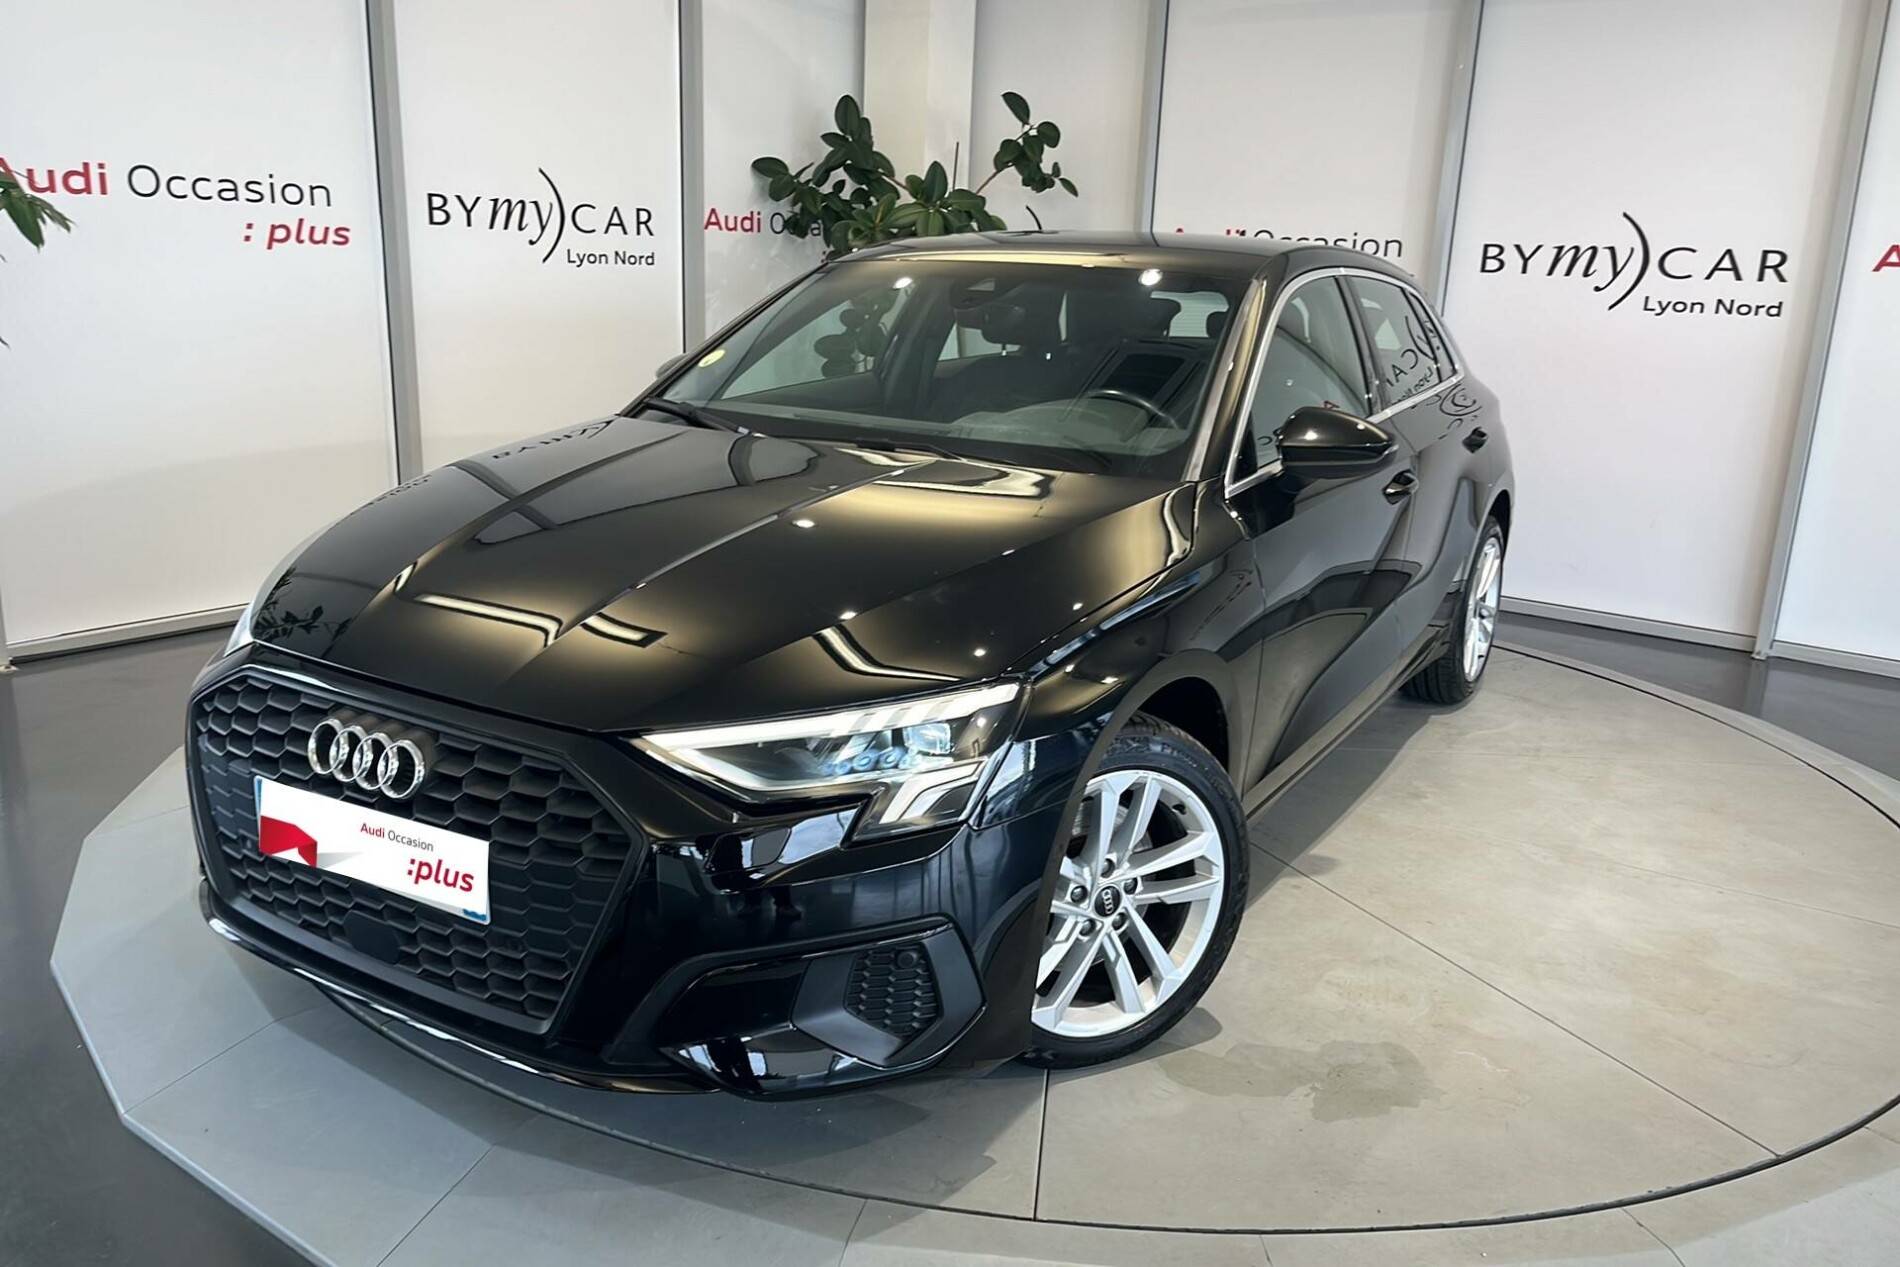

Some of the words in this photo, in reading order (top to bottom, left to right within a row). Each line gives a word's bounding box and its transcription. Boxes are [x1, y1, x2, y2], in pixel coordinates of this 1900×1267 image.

[127, 164, 332, 207] Occasion
[703, 207, 762, 233] Audi
[566, 248, 609, 267] Lyon
[614, 250, 655, 266] Nord
[1642, 295, 1705, 316] Lyon
[1714, 298, 1784, 317] Nord
[360, 822, 385, 839] Audi
[387, 829, 434, 852] Occasion
